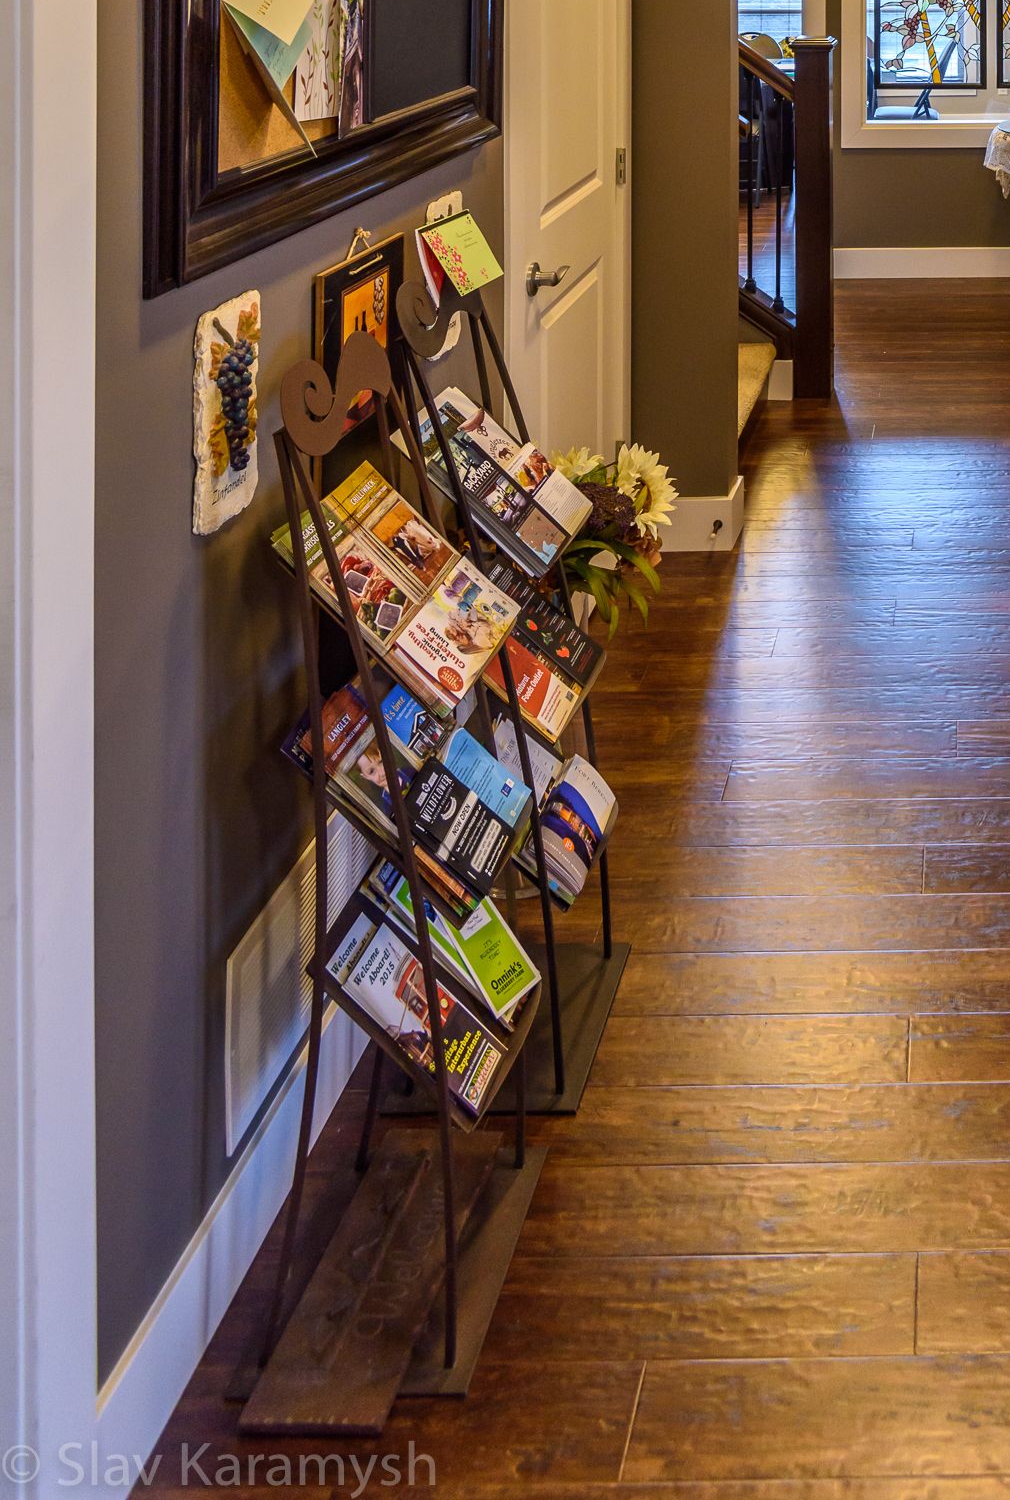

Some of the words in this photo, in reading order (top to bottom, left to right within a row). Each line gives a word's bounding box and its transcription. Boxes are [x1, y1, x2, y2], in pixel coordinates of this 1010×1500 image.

[211, 470, 247, 506] Zinfandel
[463, 459, 492, 491] BACKYARD
[350, 478, 377, 506] CHILLIWACK
[406, 629, 438, 661] Healthy,
[414, 622, 467, 669] Gluten-Free
[421, 637, 448, 663] Organic
[429, 626, 450, 648] Living
[514, 673, 531, 696] Natural
[520, 684, 535, 703] Foods
[530, 668, 544, 688] Outlet
[383, 709, 396, 723] It's
[390, 695, 407, 712] time
[327, 712, 353, 742] LANGLEY
[420, 773, 454, 823] WILDFLOWER
[450, 820, 462, 836] NOW
[459, 803, 472, 820] OPEN
[330, 937, 359, 975] Welcome
[352, 947, 382, 986] Welcome
[366, 947, 392, 985] Aboard!
[378, 961, 396, 986] 2015
[489, 959, 523, 991] Onnink's
[495, 977, 516, 996] BLUEBERRY
[514, 968, 525, 980] FARM
[445, 1038, 459, 1066] ritage
[447, 1030, 473, 1073] Interurban
[456, 1030, 483, 1074] Experience
